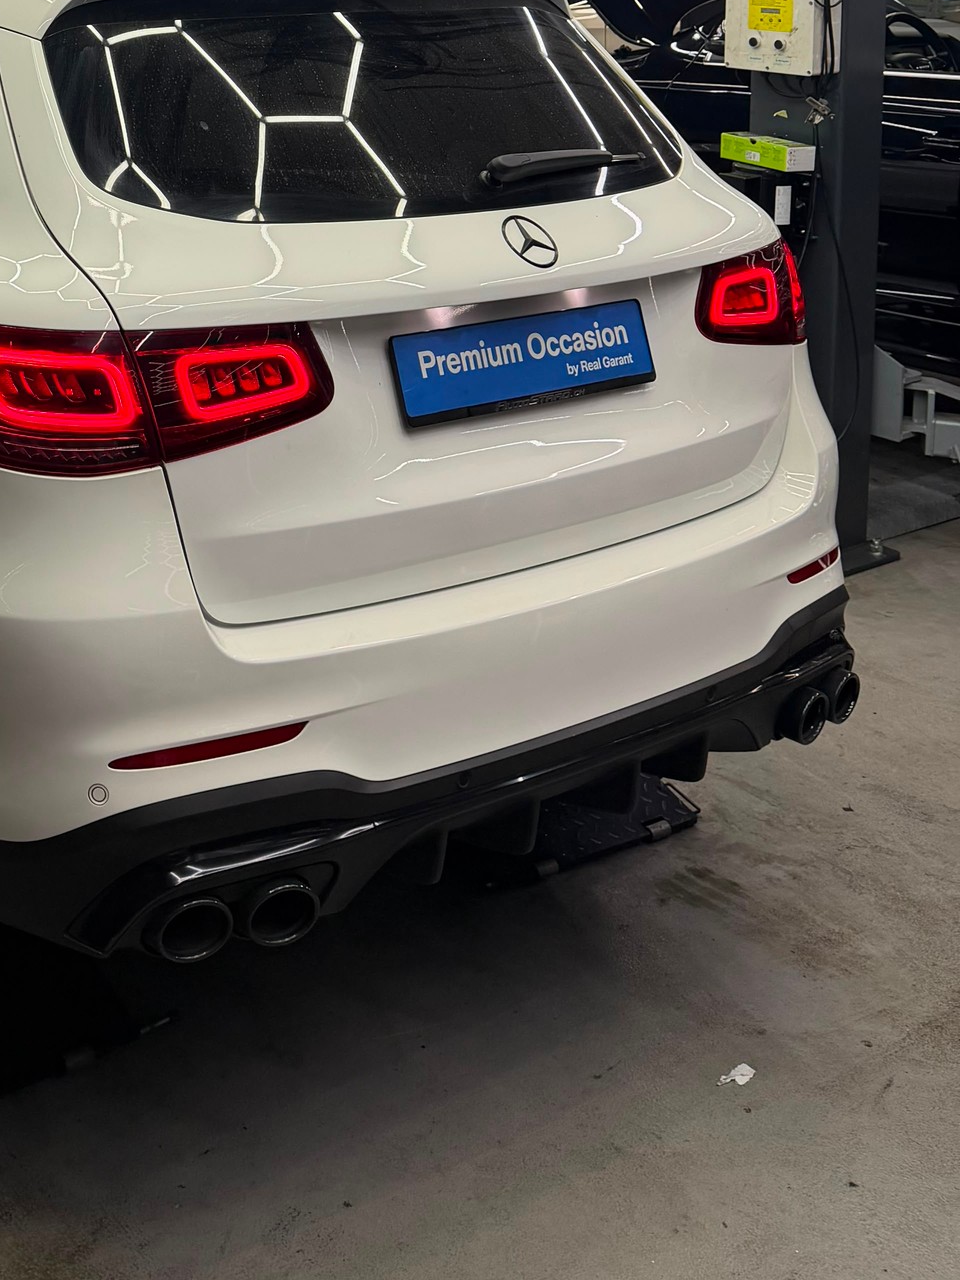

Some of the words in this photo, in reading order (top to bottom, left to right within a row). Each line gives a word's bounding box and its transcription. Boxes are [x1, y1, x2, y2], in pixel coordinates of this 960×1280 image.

[417, 339, 524, 379] Premium
[526, 321, 630, 360] Occasion
[566, 362, 579, 377] by
[581, 359, 602, 373] Real
[602, 352, 634, 368] Garant
